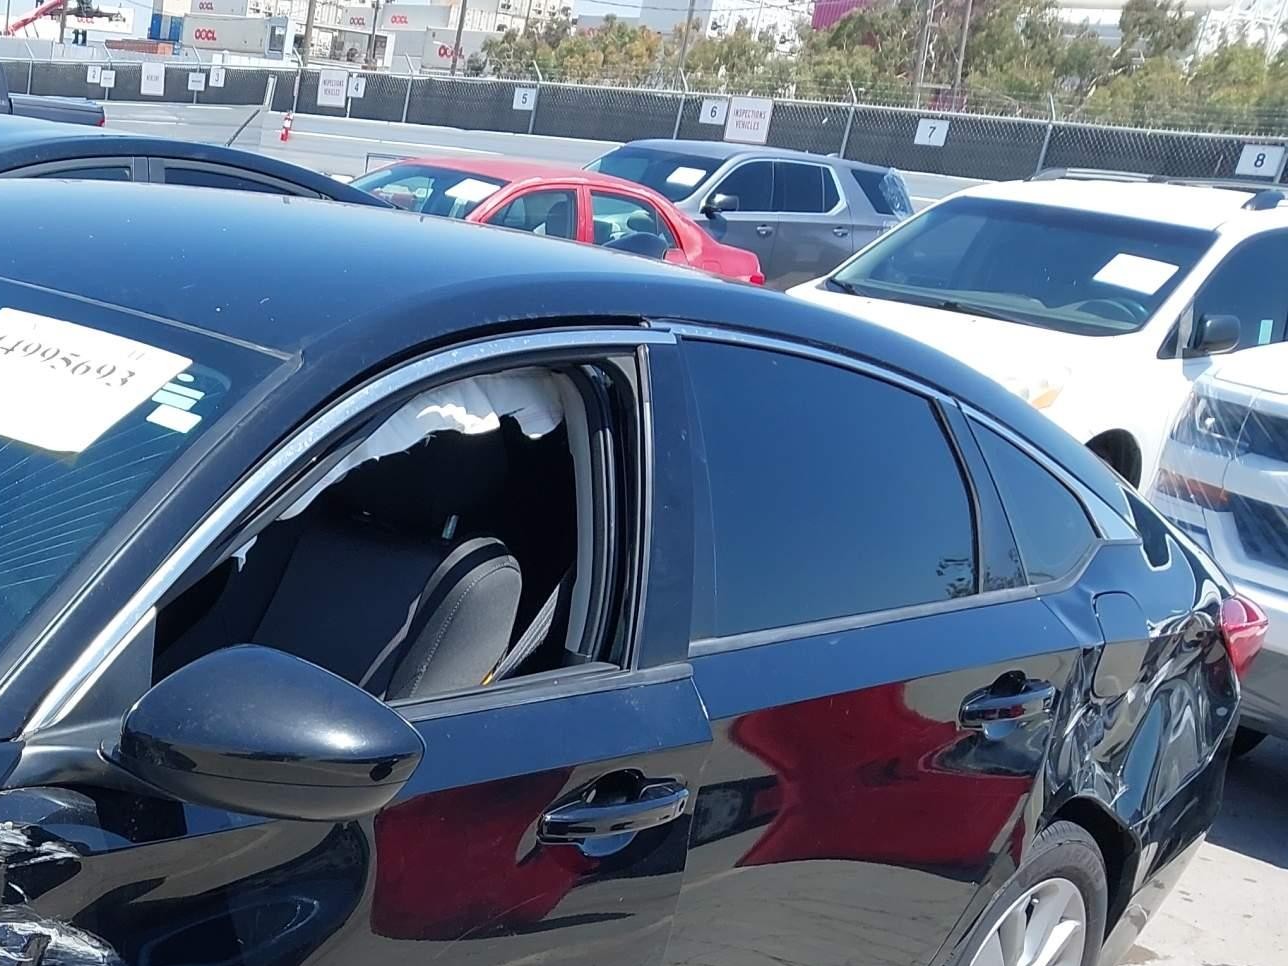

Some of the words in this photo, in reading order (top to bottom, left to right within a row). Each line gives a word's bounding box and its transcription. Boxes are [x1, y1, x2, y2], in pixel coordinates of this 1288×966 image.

[195, 29, 217, 41] OOCL
[354, 82, 360, 92] 4
[521, 93, 528, 105] 5
[710, 105, 718, 118] 6
[733, 109, 766, 120] INSPECTIONS
[735, 120, 761, 131] VEHICLES
[928, 126, 936, 138] 7
[1254, 153, 1266, 168] 8
